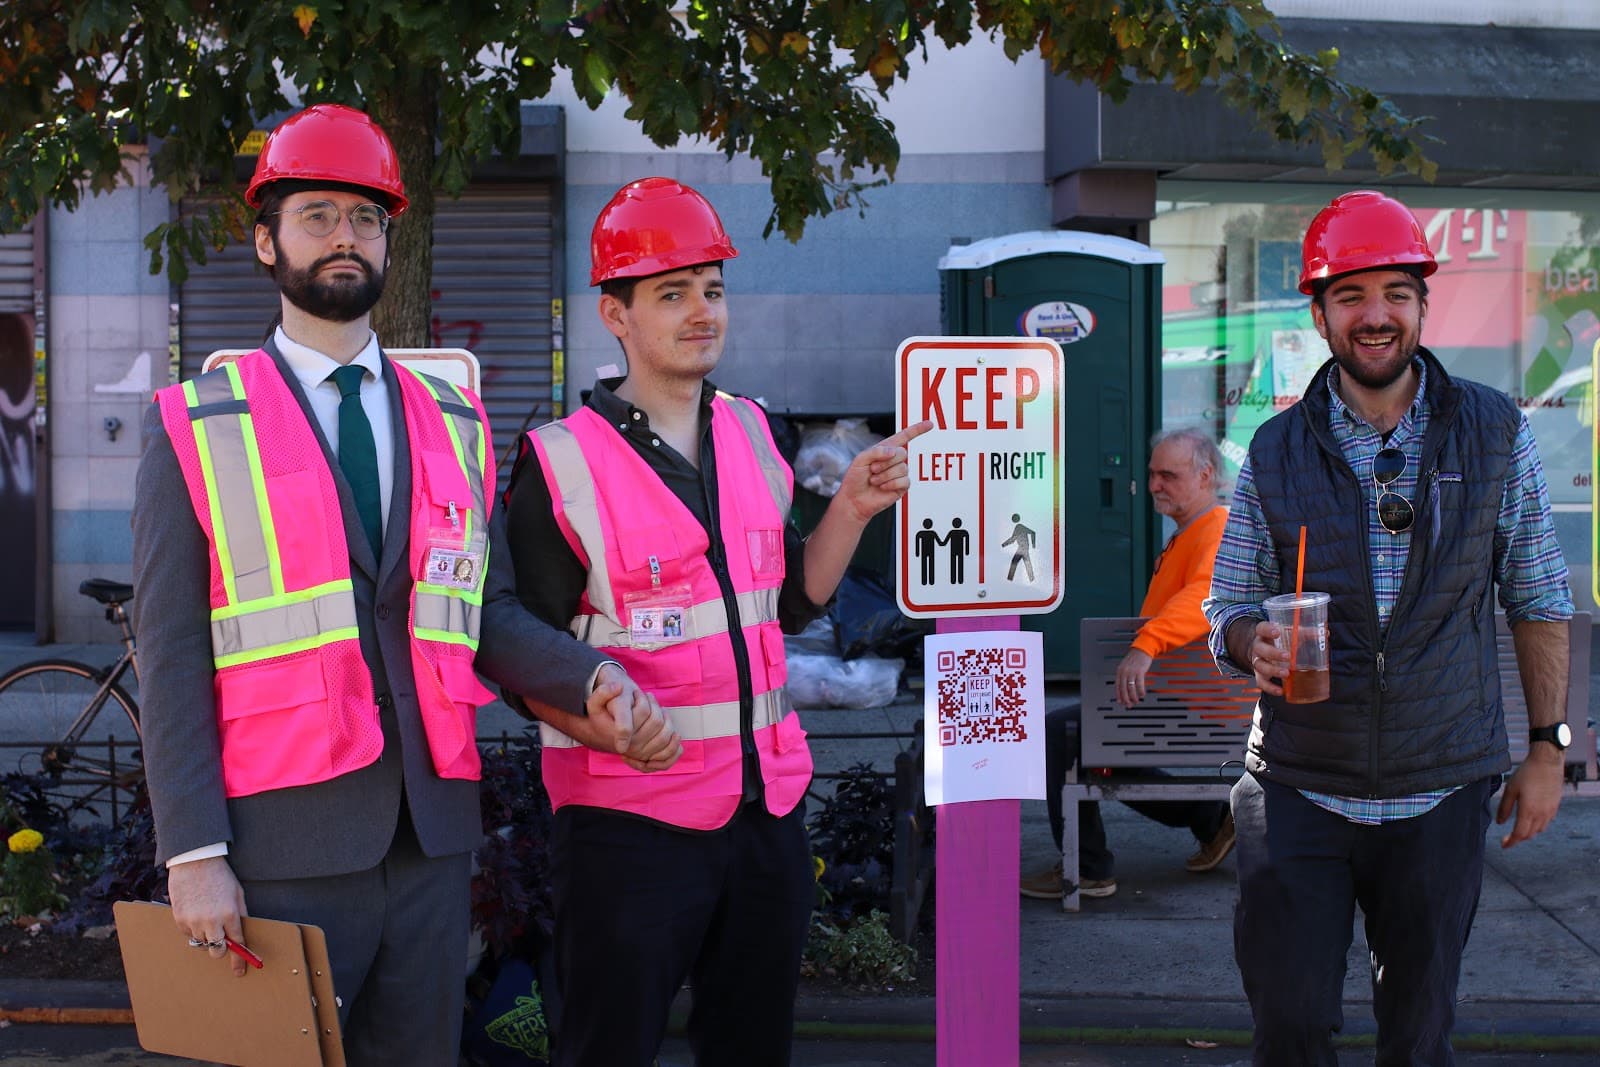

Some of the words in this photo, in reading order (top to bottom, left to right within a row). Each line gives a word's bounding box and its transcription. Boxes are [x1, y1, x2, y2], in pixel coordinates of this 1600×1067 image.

[921, 367, 1041, 430] KEEP
[918, 453, 966, 481] LEFT
[990, 451, 1046, 480] RIGHT
[970, 678, 990, 690] KEEP
